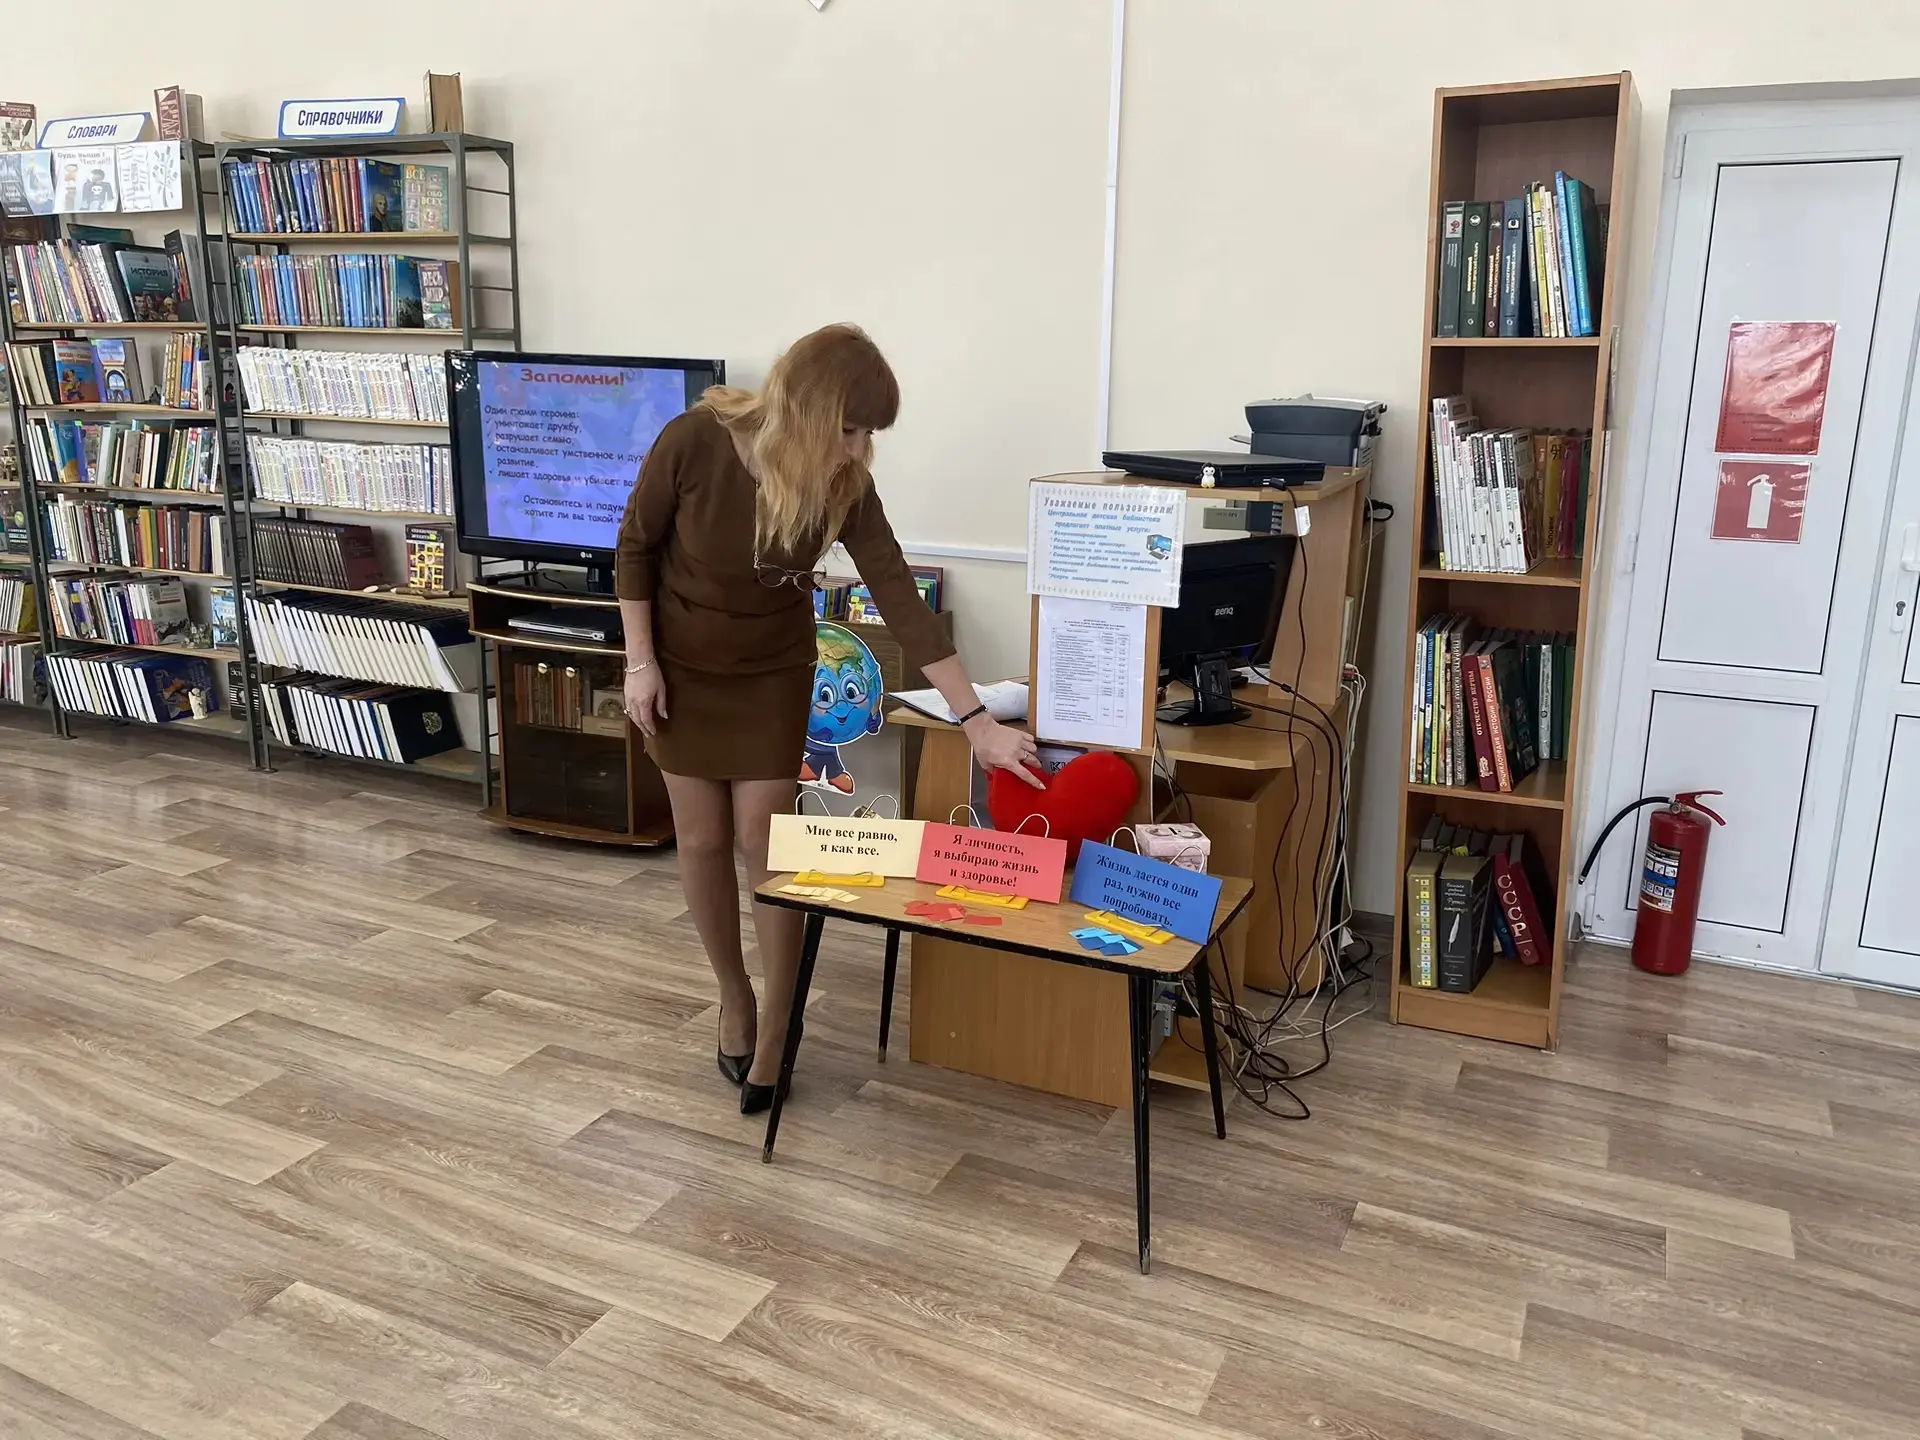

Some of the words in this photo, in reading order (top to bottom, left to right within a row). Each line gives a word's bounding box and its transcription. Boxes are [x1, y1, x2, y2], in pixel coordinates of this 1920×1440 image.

[130, 267, 169, 277] ИСТОРИЯ
[520, 368, 625, 386] Запомни!
[484, 405, 508, 415] Один
[494, 420, 543, 430] уничтожает
[495, 433, 539, 443] разрушает
[496, 445, 559, 457] останавливает
[562, 449, 614, 460] умственное
[617, 453, 624, 461] и
[498, 470, 529, 479] лишает
[533, 473, 571, 483] здоровья
[523, 494, 583, 508] Остановитесь
[1043, 496, 1097, 510] Уважаемые
[1102, 502, 1174, 514] пользователи!
[524, 508, 554, 518] хотите
[557, 511, 570, 520] ли
[572, 513, 585, 521] вы
[588, 513, 614, 524] такой
[1047, 508, 1088, 518] Центральная
[1122, 513, 1161, 523] библиотека
[1468, 670, 1477, 695] ВЕРНЫ
[1471, 697, 1483, 735] ОТЕЧЕСТВУ
[805, 824, 832, 836] Мне
[835, 829, 855, 838] все
[857, 830, 898, 843] равно,
[820, 843, 827, 852] я
[831, 844, 855, 854] как
[857, 847, 880, 856] все.
[952, 834, 962, 845] Я
[965, 838, 1024, 857] личность,
[933, 849, 940, 858] я
[944, 851, 999, 868] выбираю
[1001, 860, 1039, 875] жизнь
[949, 868, 957, 877] и
[960, 869, 1017, 887] здоровье!
[1096, 854, 1132, 876] Жизнь
[1133, 868, 1170, 888] дается
[1171, 881, 1199, 899] один
[1103, 877, 1124, 891] раз,
[1126, 884, 1161, 904] нужно
[1163, 897, 1181, 911] все
[1102, 894, 1173, 927] попробовать.
[1497, 874, 1527, 937] СССР
